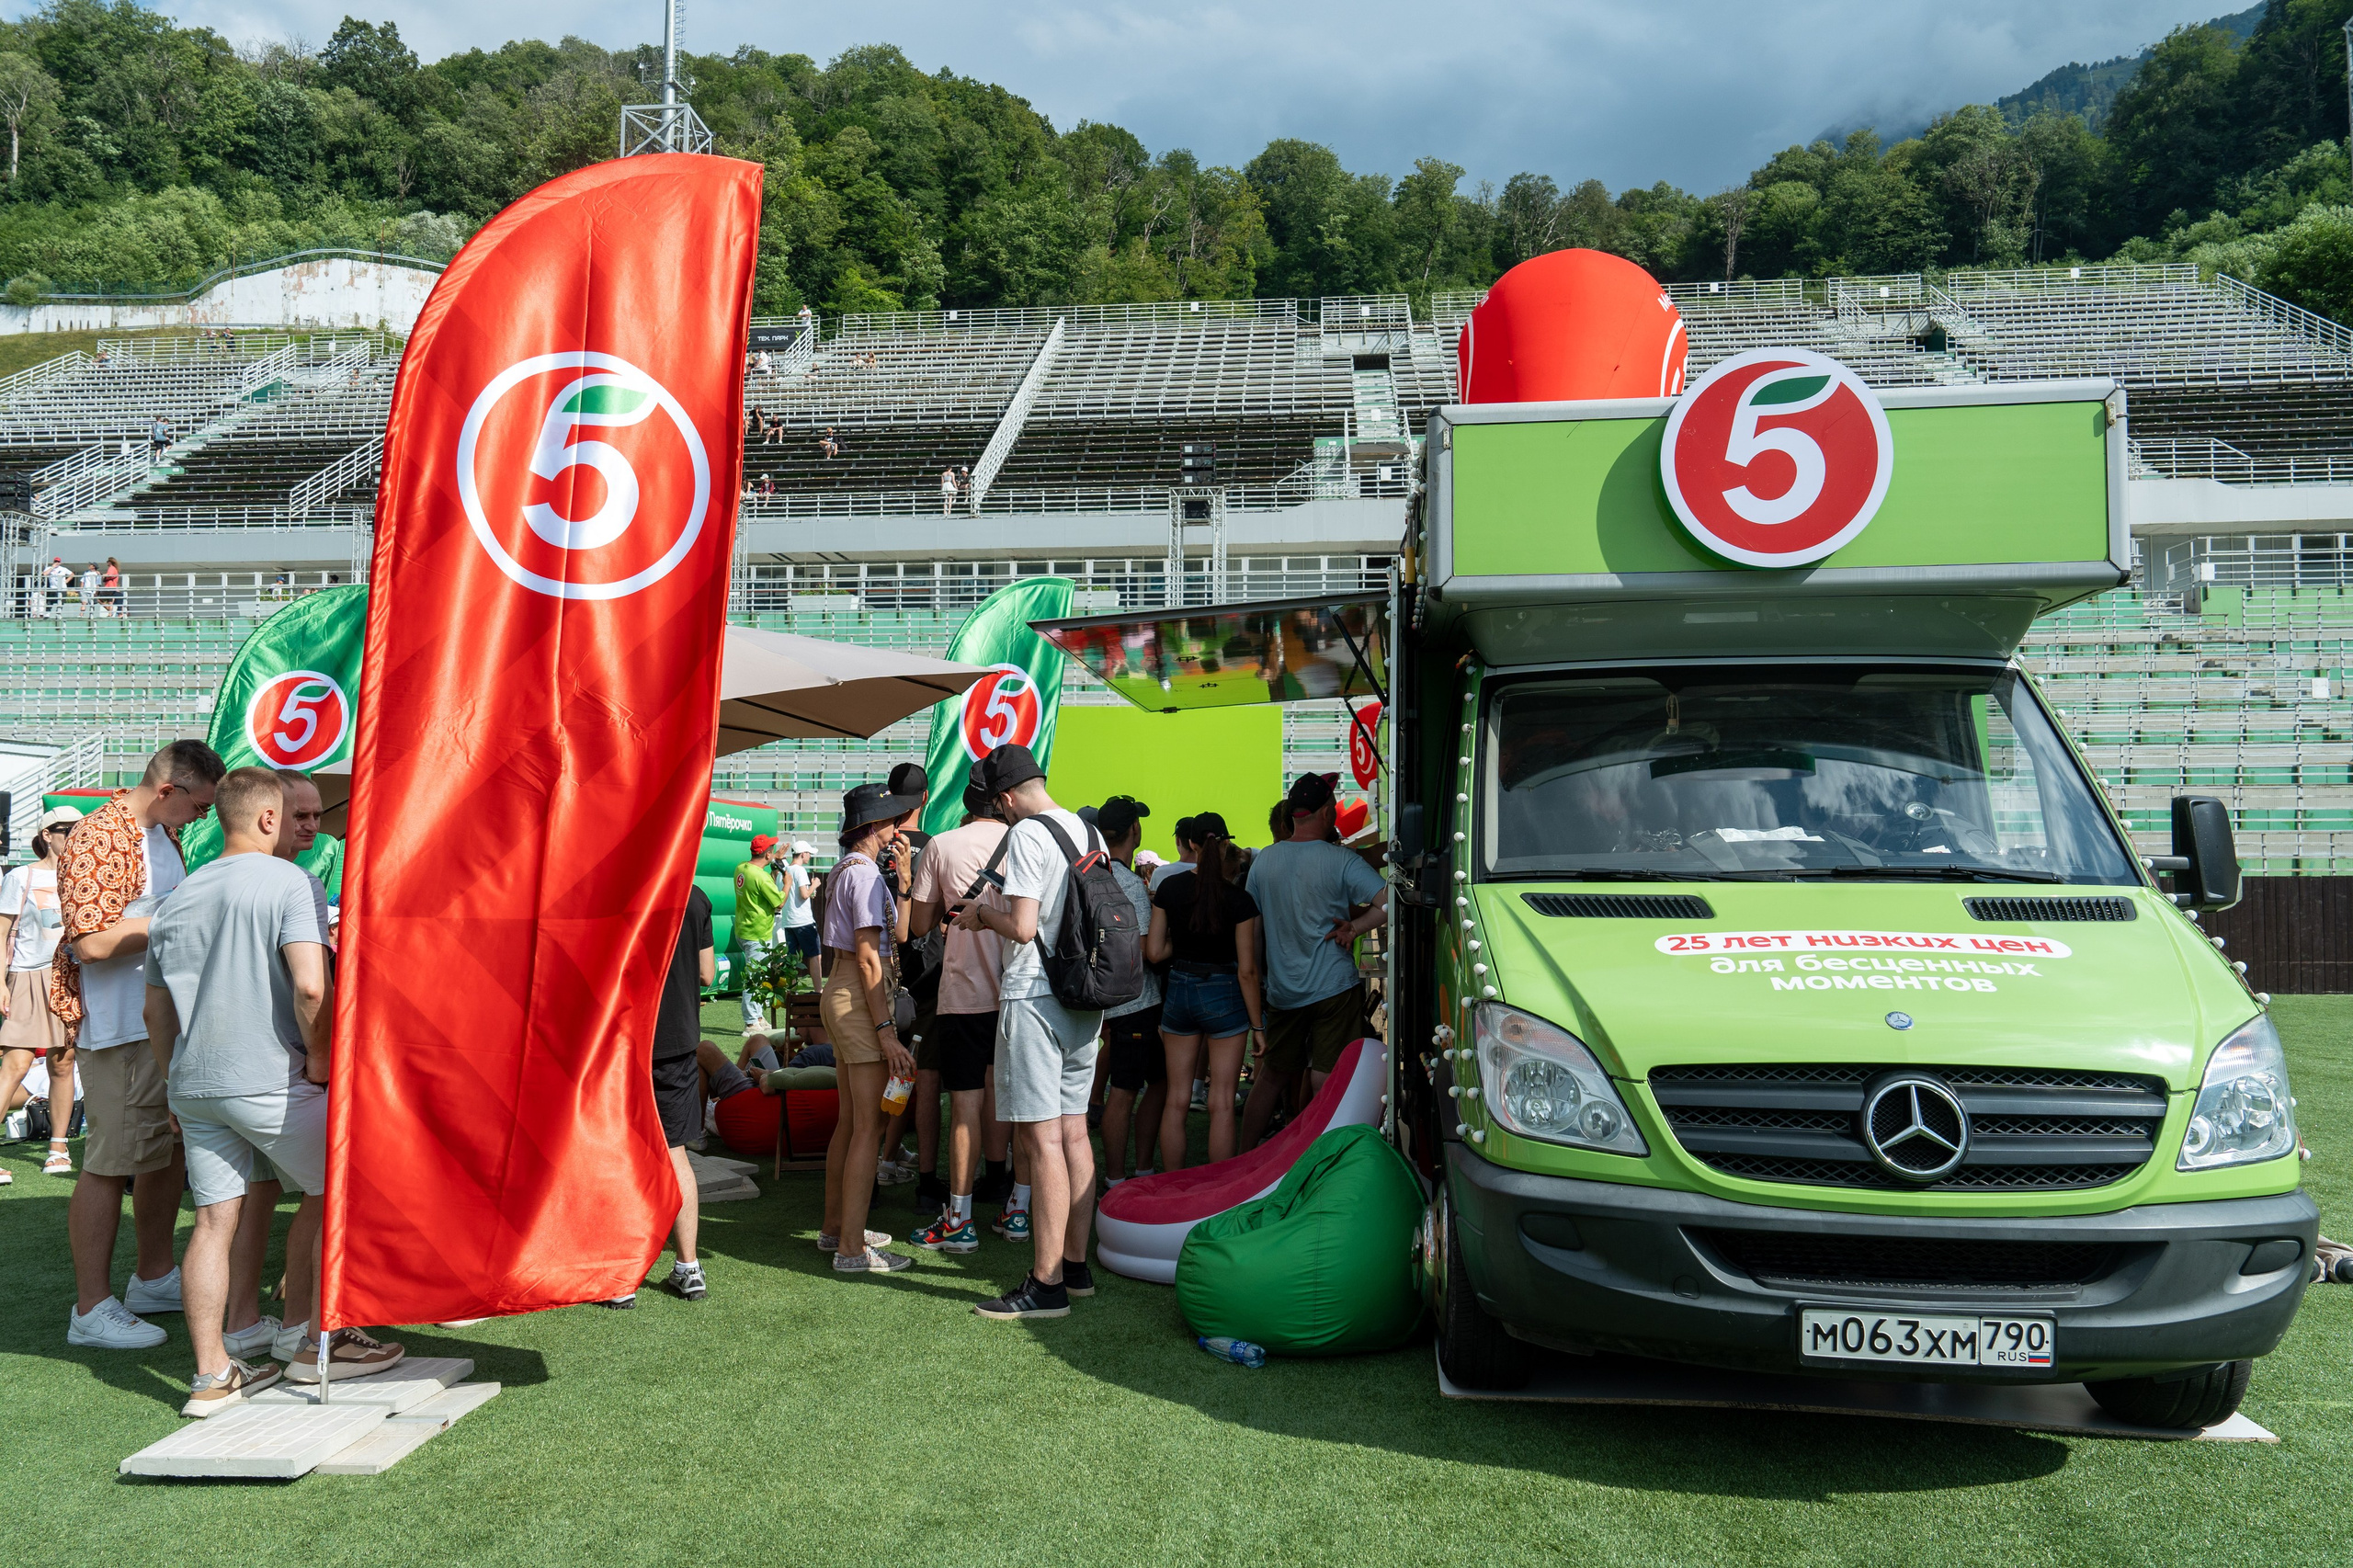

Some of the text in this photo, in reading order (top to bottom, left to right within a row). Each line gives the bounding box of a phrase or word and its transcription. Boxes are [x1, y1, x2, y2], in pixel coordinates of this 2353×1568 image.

[521, 372, 656, 550] 5
[1722, 367, 1840, 525] 5
[273, 680, 332, 753] 5
[980, 674, 1028, 749] 5
[709, 811, 753, 834] Пятёрочка
[1667, 935, 2054, 954] 25 лет низких цен
[1710, 953, 2043, 978] для бесценных
[1769, 975, 1998, 993] моментов
[1812, 1315, 2046, 1360] М063ХМ 790
[1997, 1351, 2027, 1362] RUS
